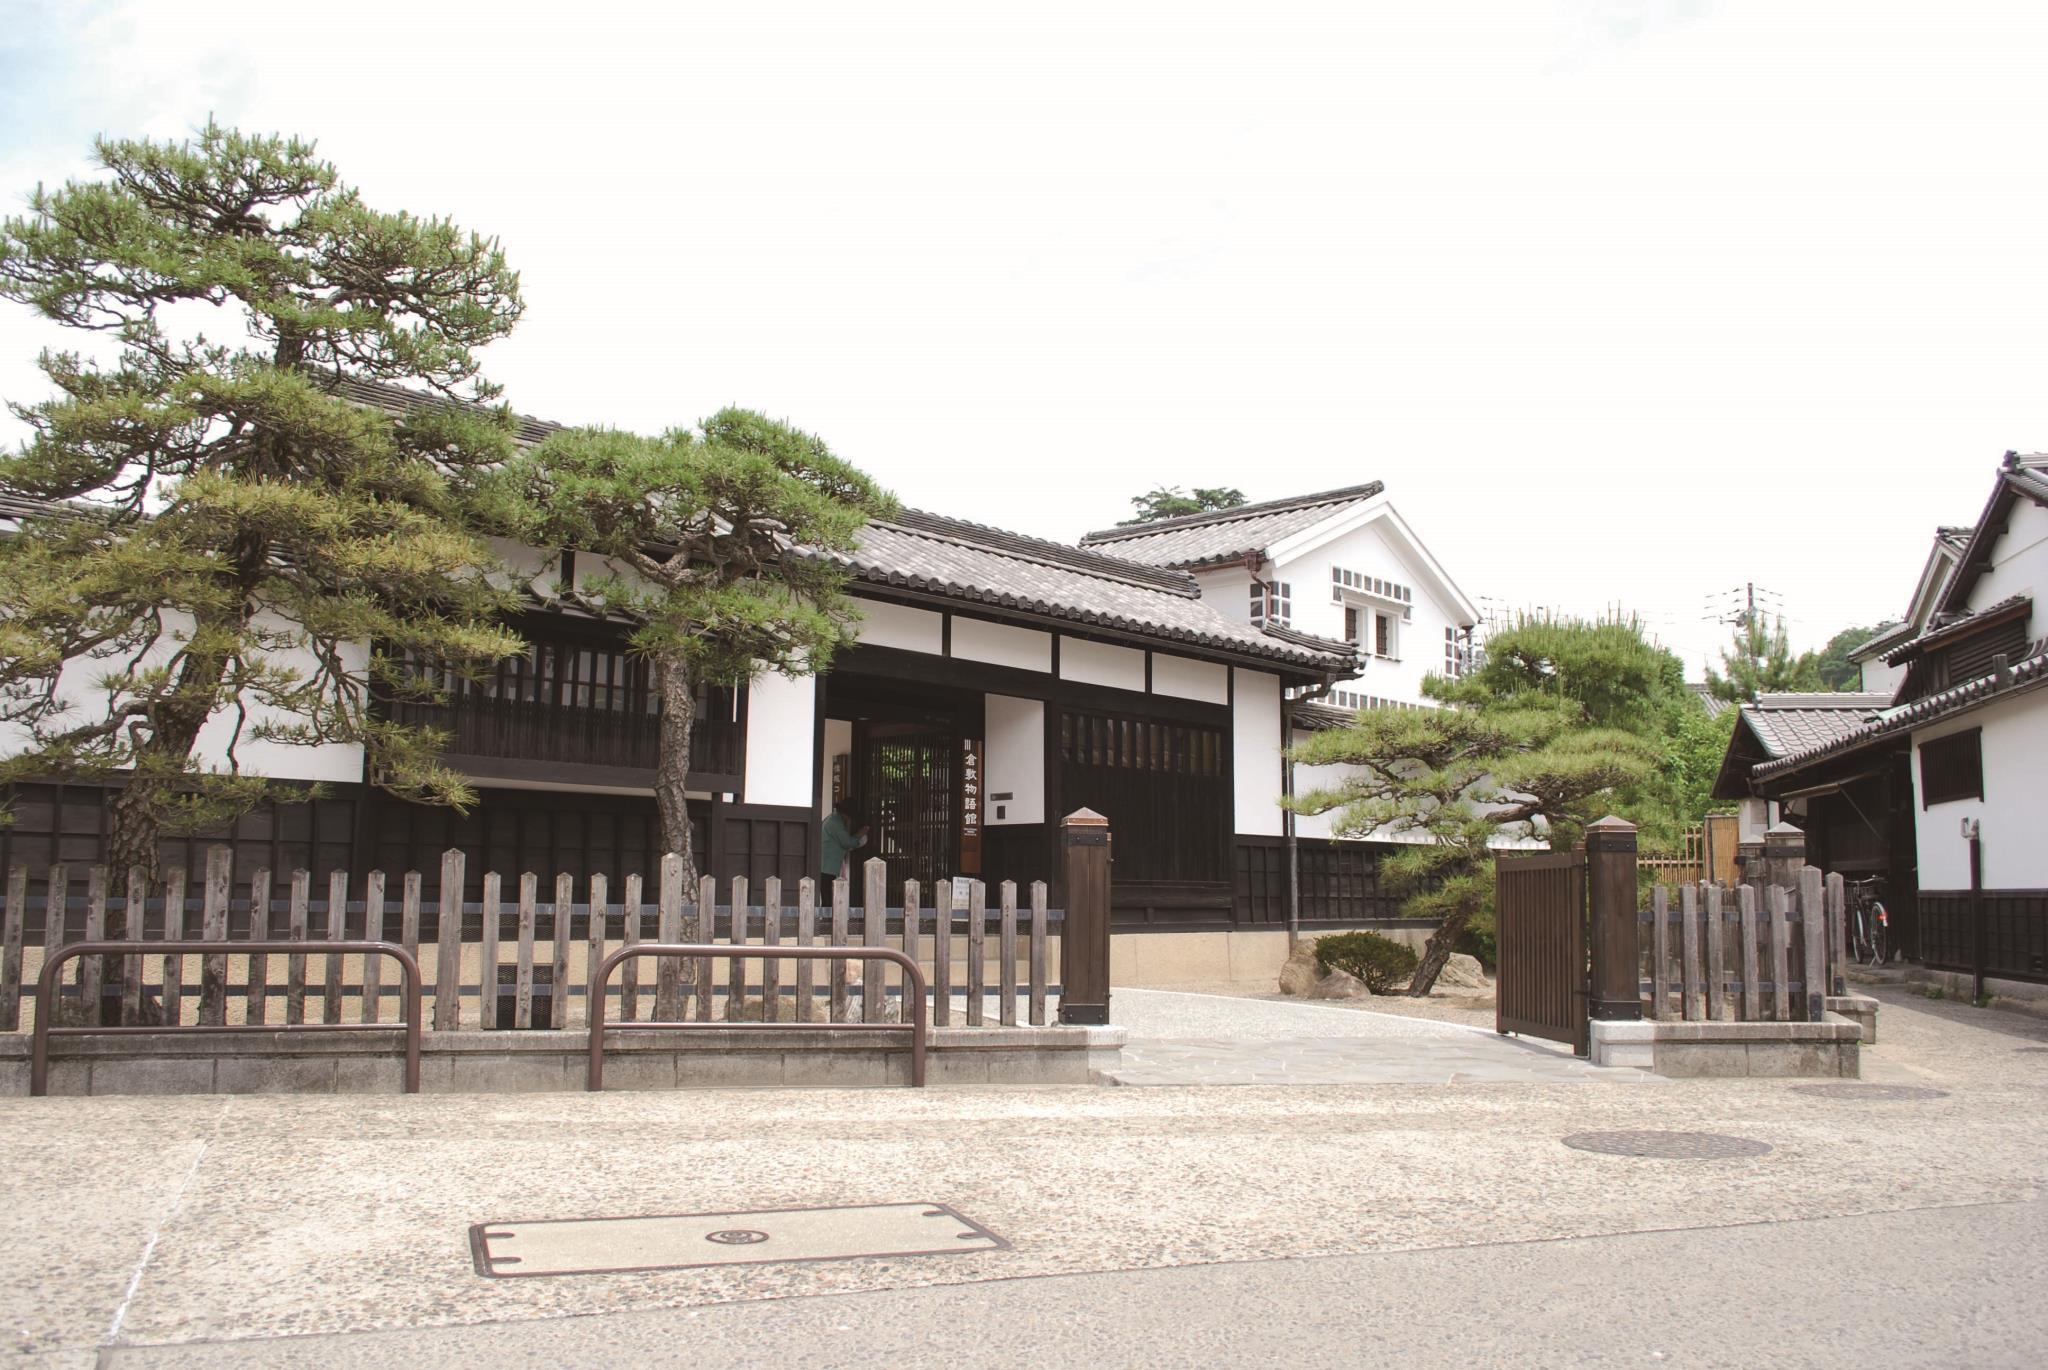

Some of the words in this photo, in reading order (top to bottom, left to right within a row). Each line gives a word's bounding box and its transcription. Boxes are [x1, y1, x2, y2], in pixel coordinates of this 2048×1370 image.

[964, 753, 977, 825] 倉敷物語館
